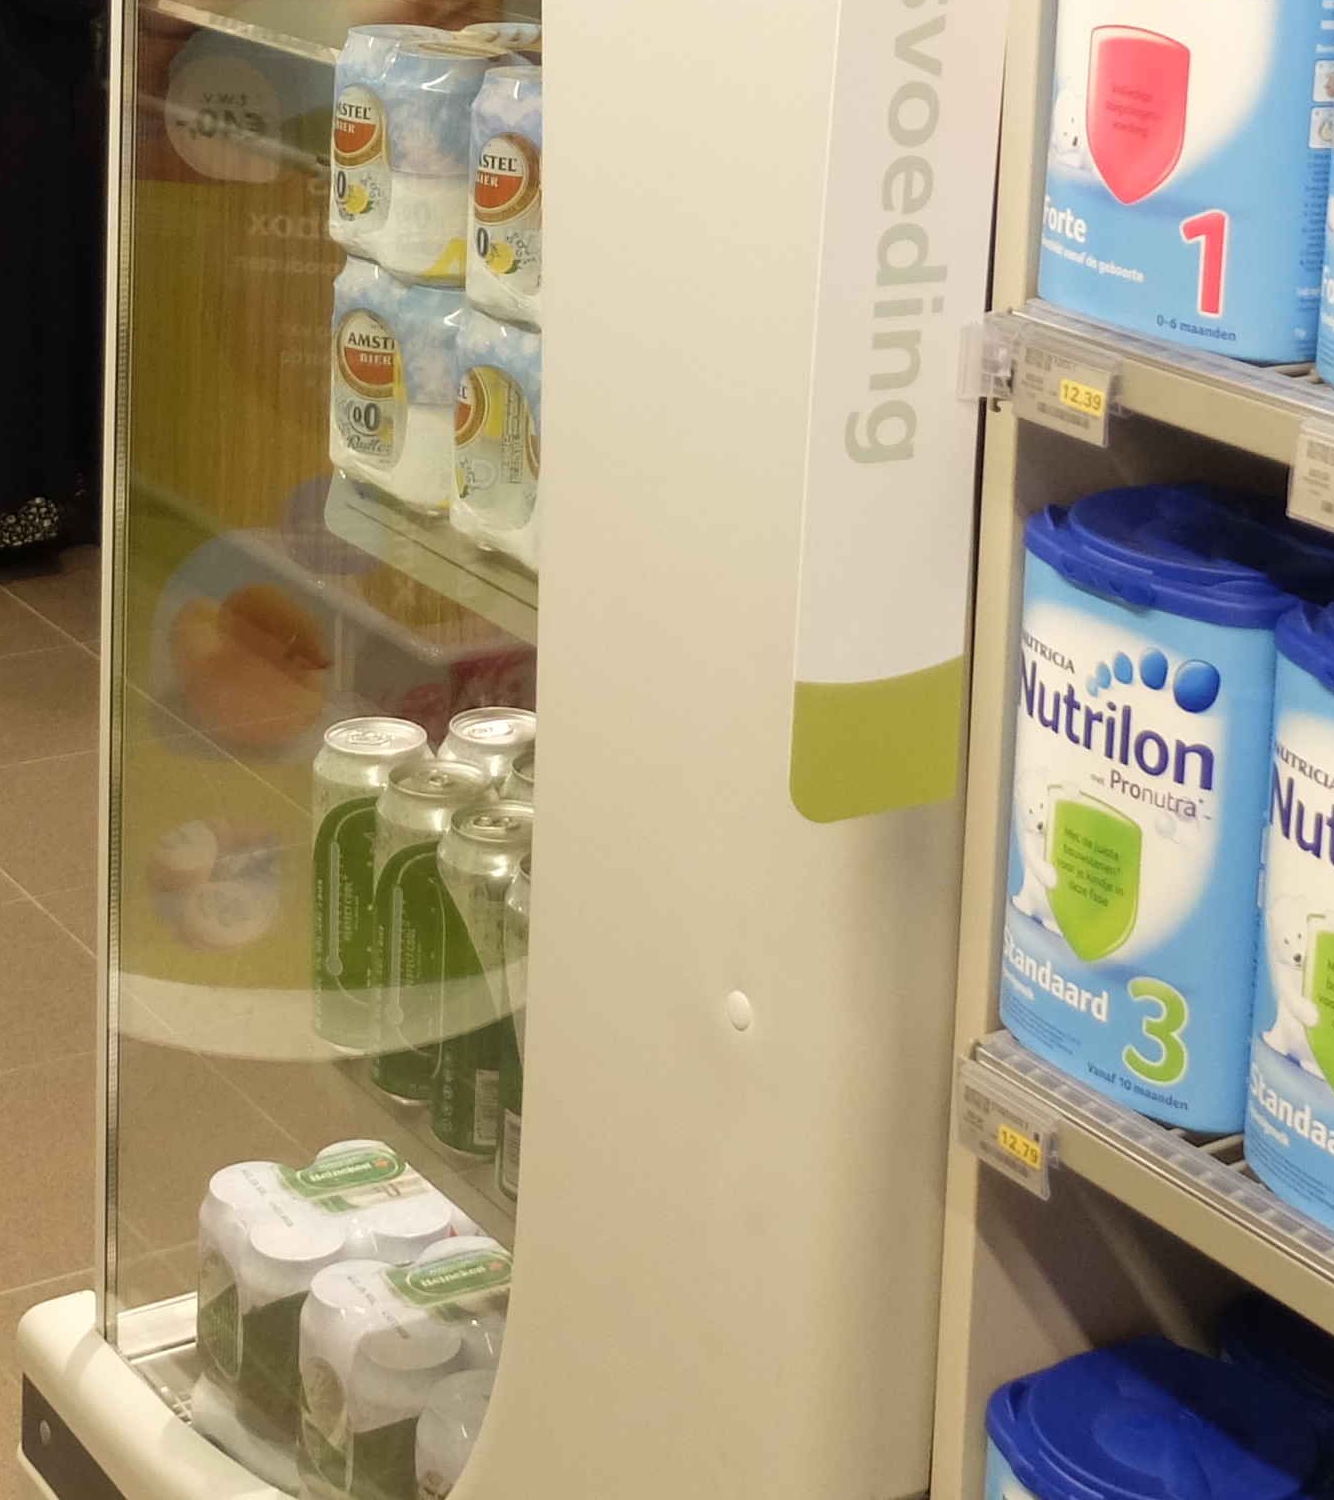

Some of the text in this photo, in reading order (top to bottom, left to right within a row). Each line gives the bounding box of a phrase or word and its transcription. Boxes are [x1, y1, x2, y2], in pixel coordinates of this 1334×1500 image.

[1180, 209, 1229, 317] 1
[348, 332, 395, 350] AMST
[1180, 319, 1236, 342] maanden
[360, 352, 394, 366] BIER
[1019, 653, 1214, 791] Nutrilon
[1122, 977, 1188, 1084] 3
[1134, 1084, 1188, 1111] maanden
[310, 1161, 372, 1182] Heineken
[420, 1265, 486, 1288] Heineken
